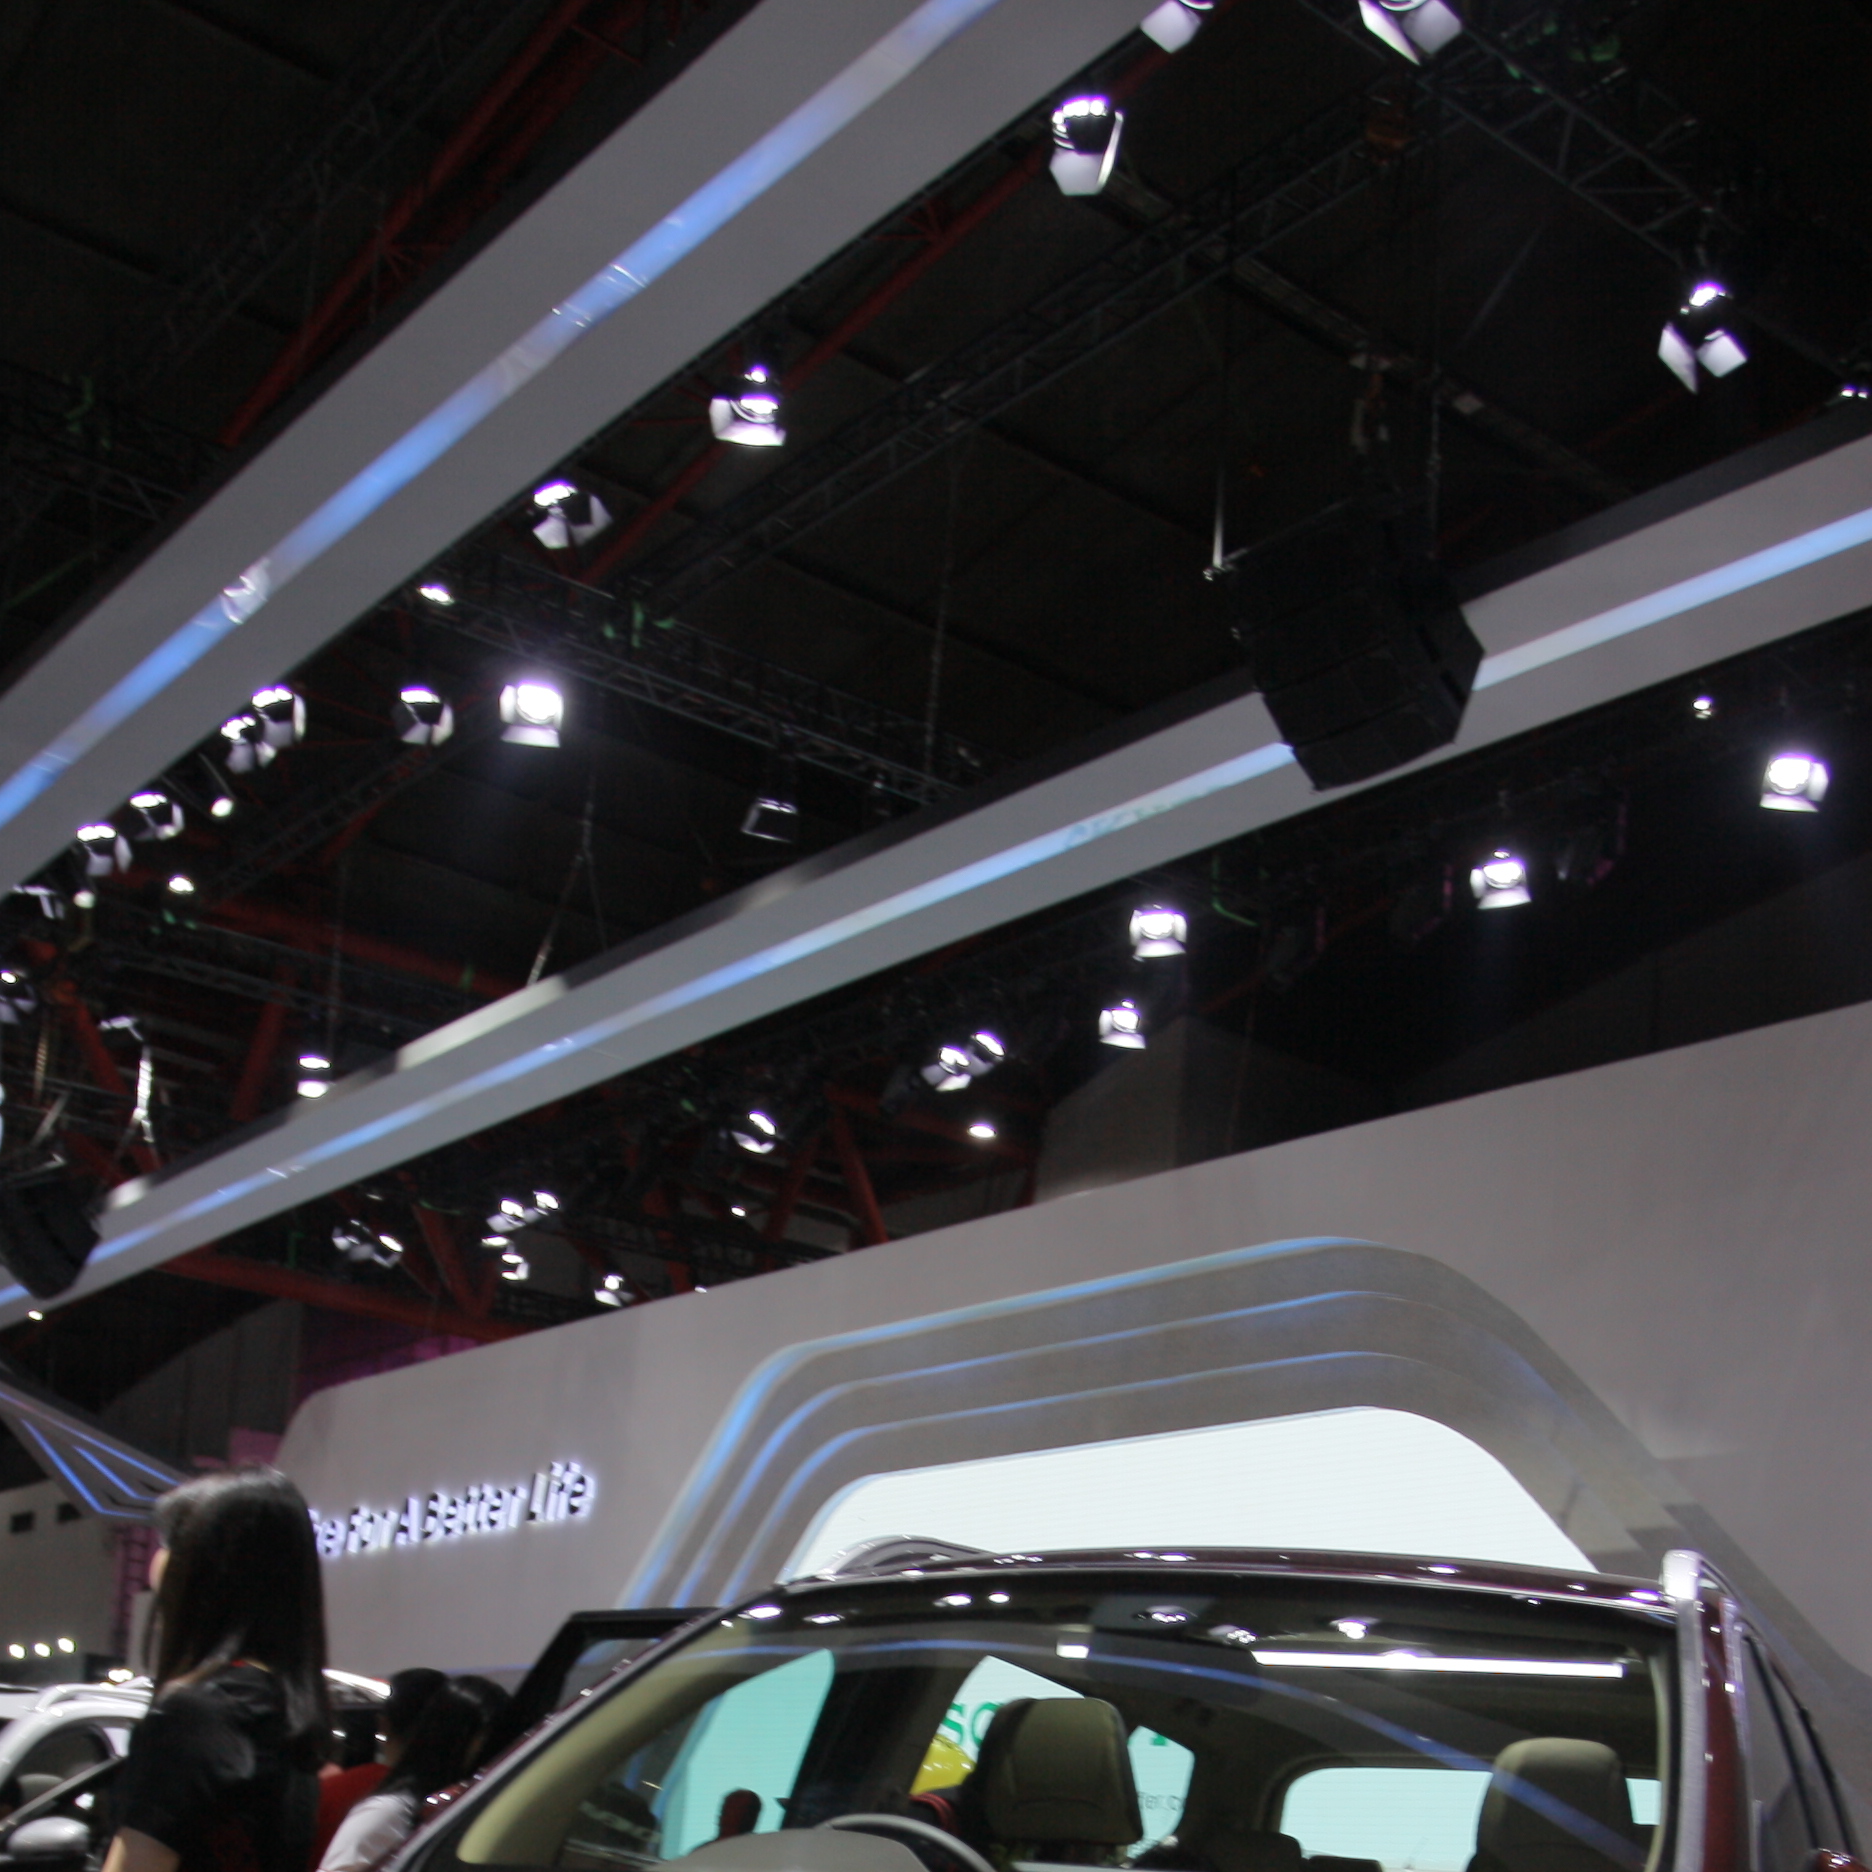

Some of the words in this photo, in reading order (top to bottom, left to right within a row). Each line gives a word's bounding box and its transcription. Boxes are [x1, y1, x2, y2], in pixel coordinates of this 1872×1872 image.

[395, 1497, 420, 1546] A
[422, 1483, 528, 1542] Better
[527, 1461, 596, 1524] Life
